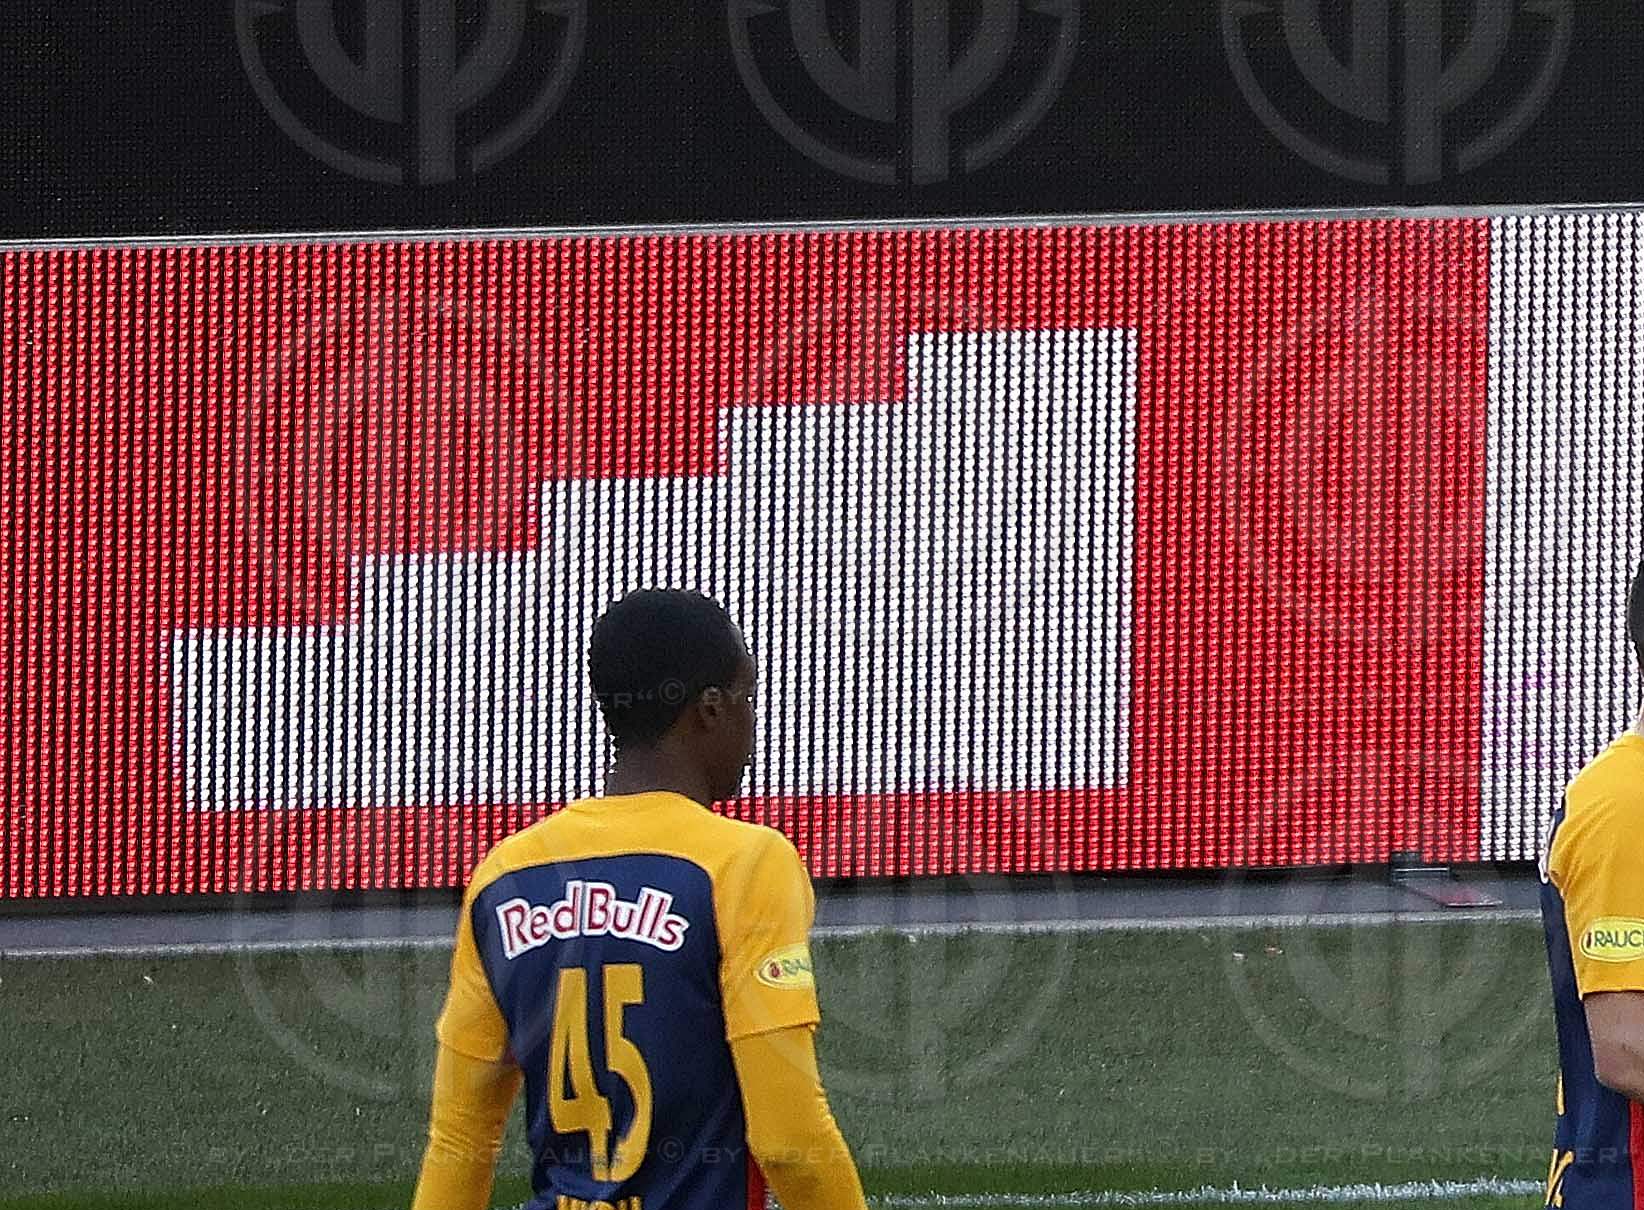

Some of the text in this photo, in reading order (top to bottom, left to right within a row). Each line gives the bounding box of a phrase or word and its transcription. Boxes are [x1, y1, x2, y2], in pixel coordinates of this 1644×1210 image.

[503, 886, 683, 953] Red Bulls
[547, 963, 653, 1183] 45
